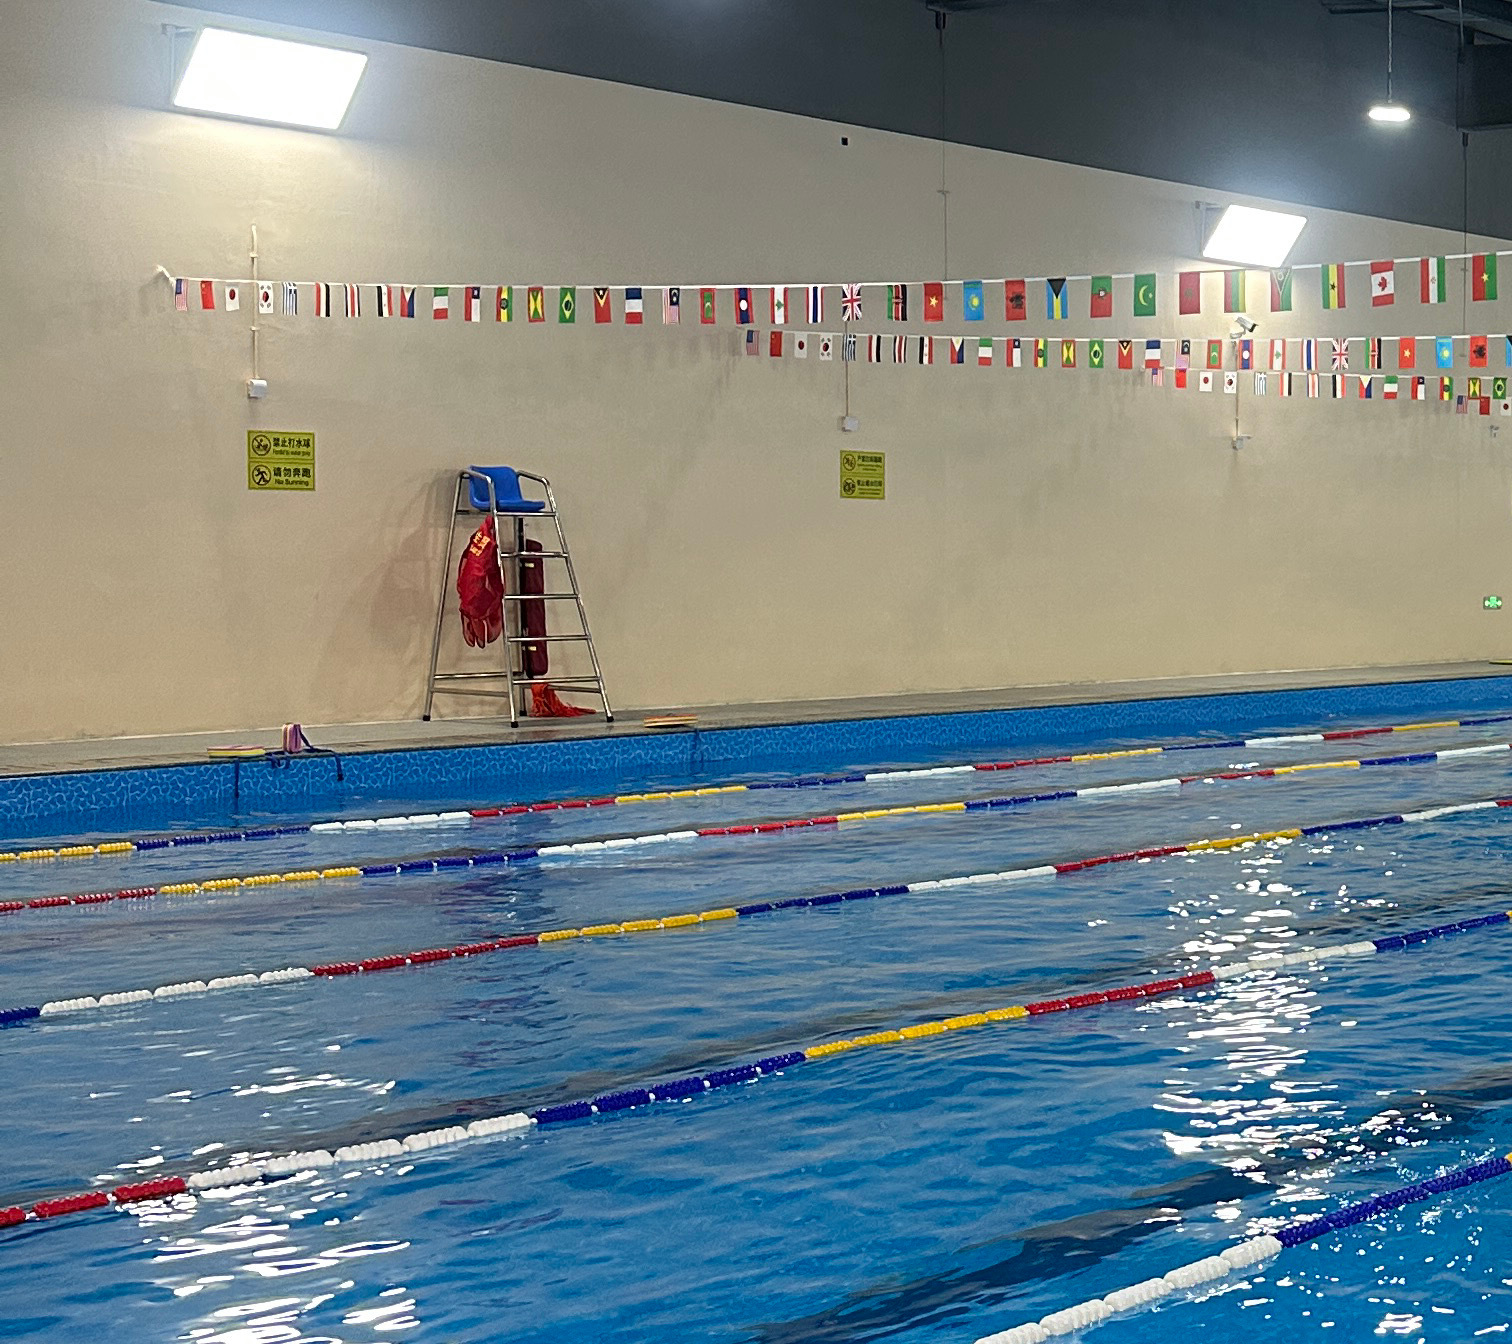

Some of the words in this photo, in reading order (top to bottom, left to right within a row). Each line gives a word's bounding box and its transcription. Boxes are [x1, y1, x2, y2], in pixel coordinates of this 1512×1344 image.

[272, 437, 311, 449] 禁止打水球
[273, 467, 311, 478] 请勿奔跑
